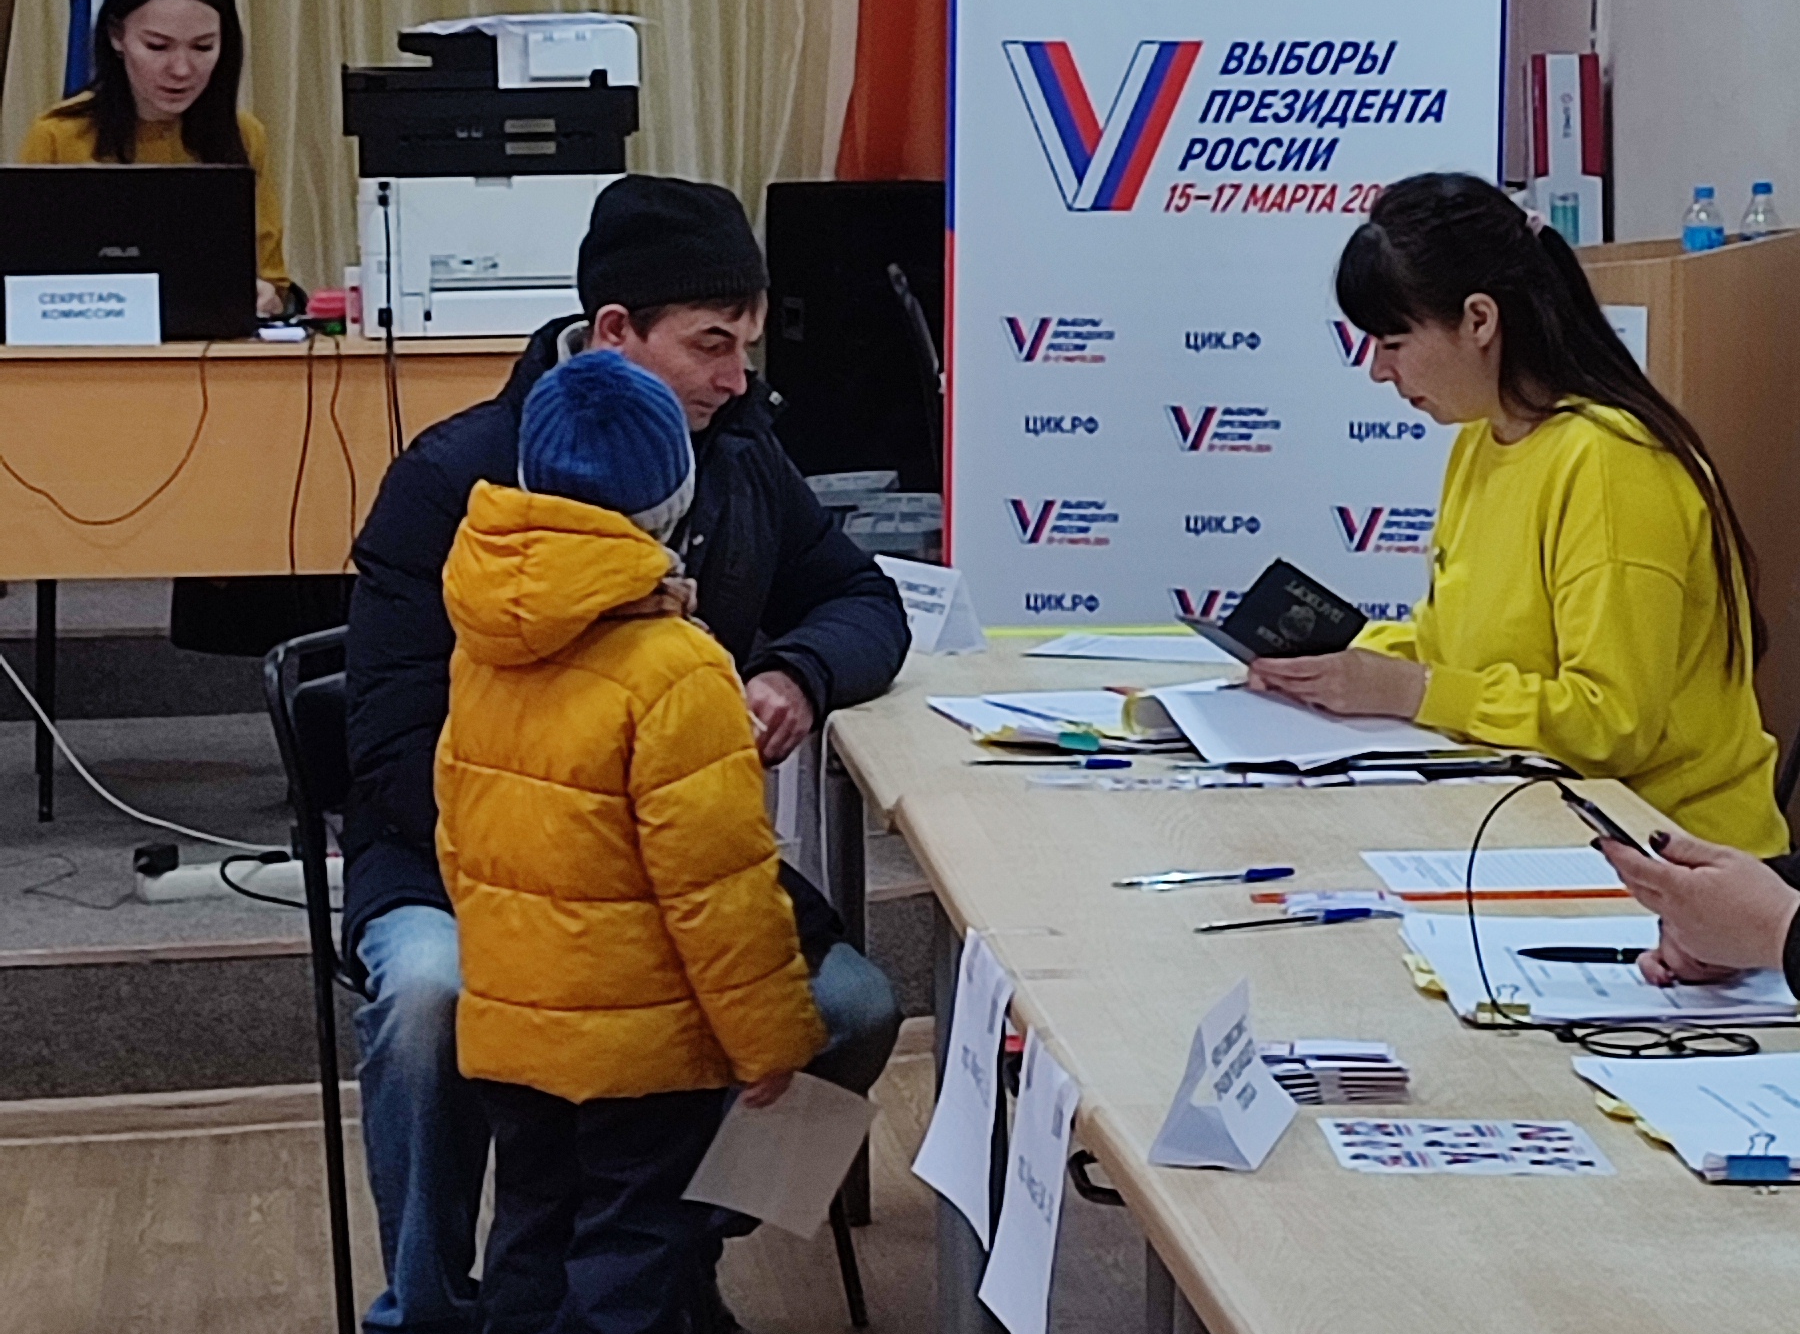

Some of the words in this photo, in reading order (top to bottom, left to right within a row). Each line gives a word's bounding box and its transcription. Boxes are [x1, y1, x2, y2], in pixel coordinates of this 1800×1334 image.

[1219, 40, 1397, 75] ВЫБОРЫ
[1198, 88, 1447, 129] ПРЕЗИДЕНТА
[1177, 137, 1339, 171] РОССИИ
[1241, 183, 1338, 213] МАРТА
[1340, 183, 1382, 213] 20
[1185, 331, 1262, 351] ЦИК.РФ
[1024, 415, 1099, 435] ЦИК.РФ
[1349, 421, 1426, 441] ЦИК.РФ
[1185, 515, 1262, 535] ЦИК.РФ
[1025, 593, 1100, 614] ЦИК.РФ
